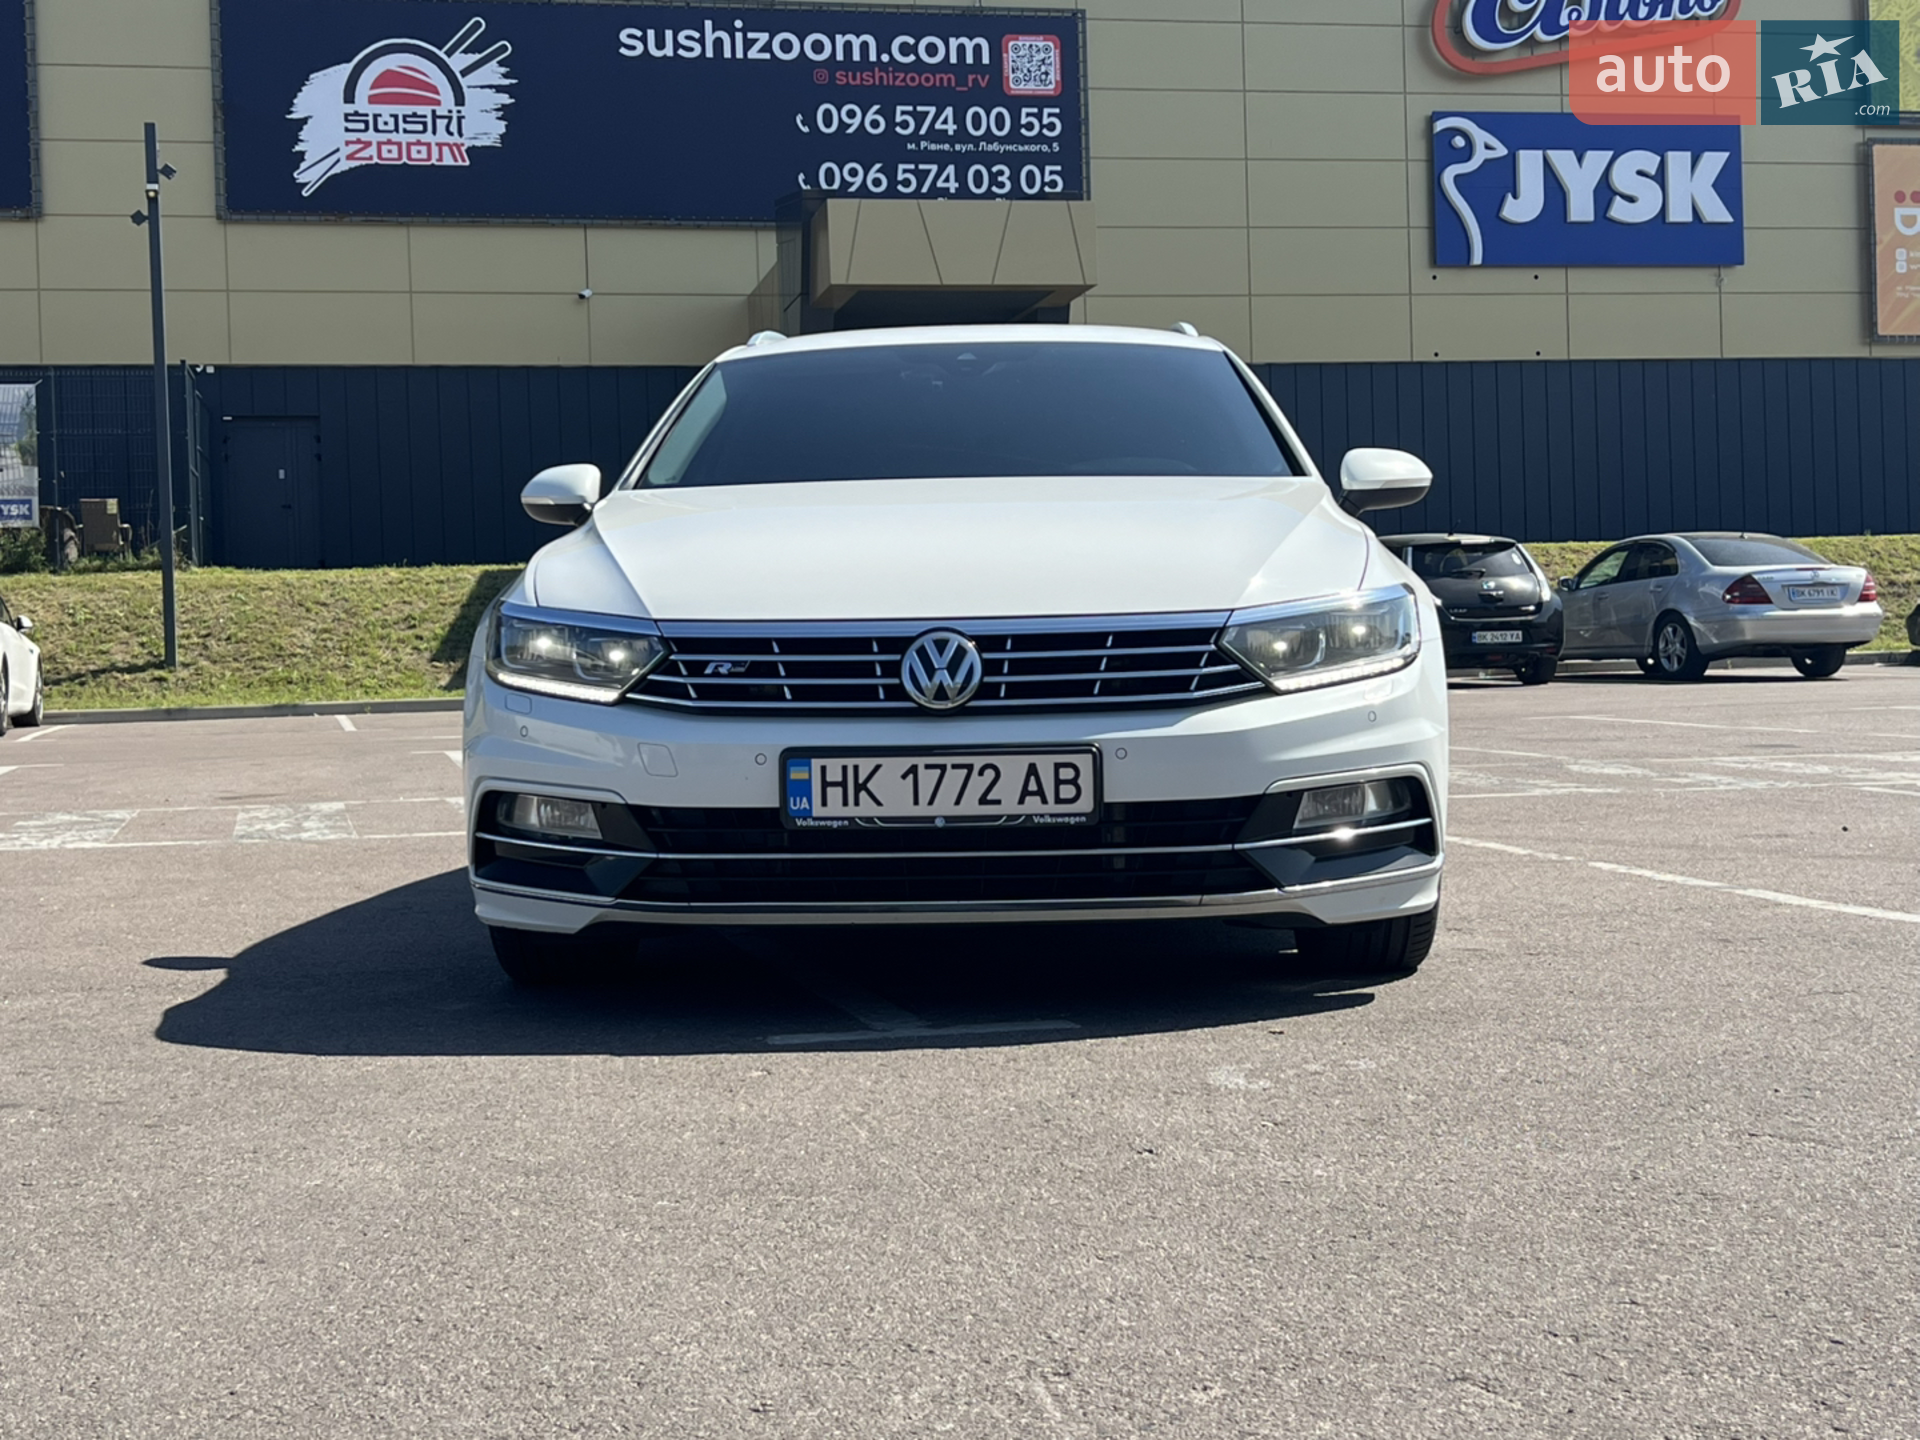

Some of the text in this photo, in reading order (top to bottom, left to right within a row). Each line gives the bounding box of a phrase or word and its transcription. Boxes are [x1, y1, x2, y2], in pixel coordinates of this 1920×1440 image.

[618, 19, 991, 65] sushizoom.com
[835, 67, 990, 91] sushizoom_rv
[343, 109, 466, 139] sushi
[816, 103, 1062, 138] 096 574 00 55
[906, 140, 1060, 155] м. Рівне, вул. Лабунського, 5
[818, 161, 1064, 195] 096 574 03 05
[1499, 149, 1734, 224] JYSK
[820, 761, 1082, 808] HK 1772 AB
[789, 797, 810, 810] UA
[796, 818, 849, 829] Volkswagen
[1032, 815, 1087, 827] Volkswagen
